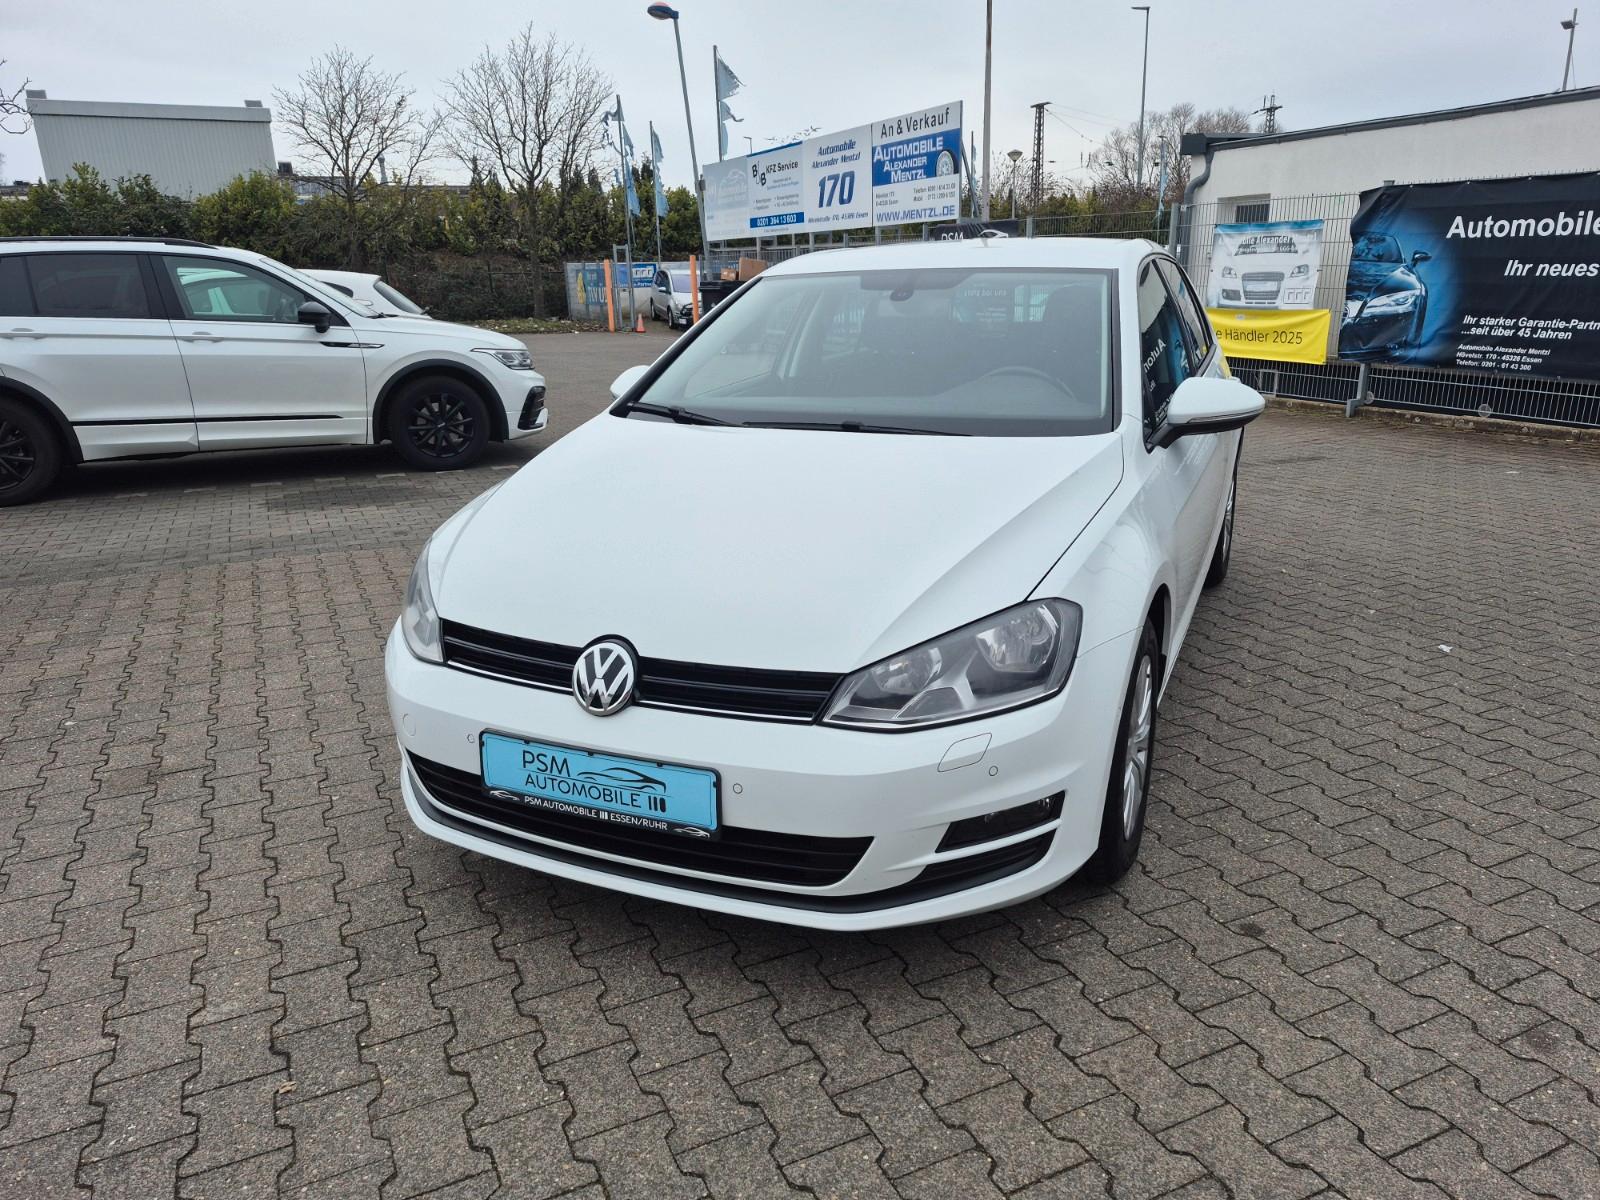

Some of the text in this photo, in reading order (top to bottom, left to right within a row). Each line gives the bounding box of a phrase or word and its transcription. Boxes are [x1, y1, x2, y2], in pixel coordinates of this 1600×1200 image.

[881, 107, 949, 138] An & Verkauf
[874, 137, 943, 162] AUTOMOBILE
[766, 160, 799, 174] KFZ Service
[883, 156, 927, 172] ALEXANDER
[891, 169, 926, 183] MENTZL
[818, 170, 855, 208] 170
[876, 205, 955, 222] WWW.MENTZL.DE
[1504, 259, 1600, 277] Ihr neues
[1462, 315, 1478, 325] Ihr
[1479, 316, 1516, 327] starker
[1225, 328, 1269, 342] Händler
[1272, 330, 1303, 345] 2025
[1490, 326, 1516, 337] über
[1517, 328, 1531, 338] 45
[1532, 329, 1573, 340] Jahren
[1457, 343, 1494, 352] Automobile
[1494, 346, 1527, 355] Alexander
[1501, 354, 1521, 362] 45326
[1521, 356, 1543, 364] Essen
[522, 749, 571, 778] PSM
[525, 773, 642, 808] AUTOMOBILE
[524, 795, 668, 831] PSM AUTOMOBILE ESSEN/RUHR
